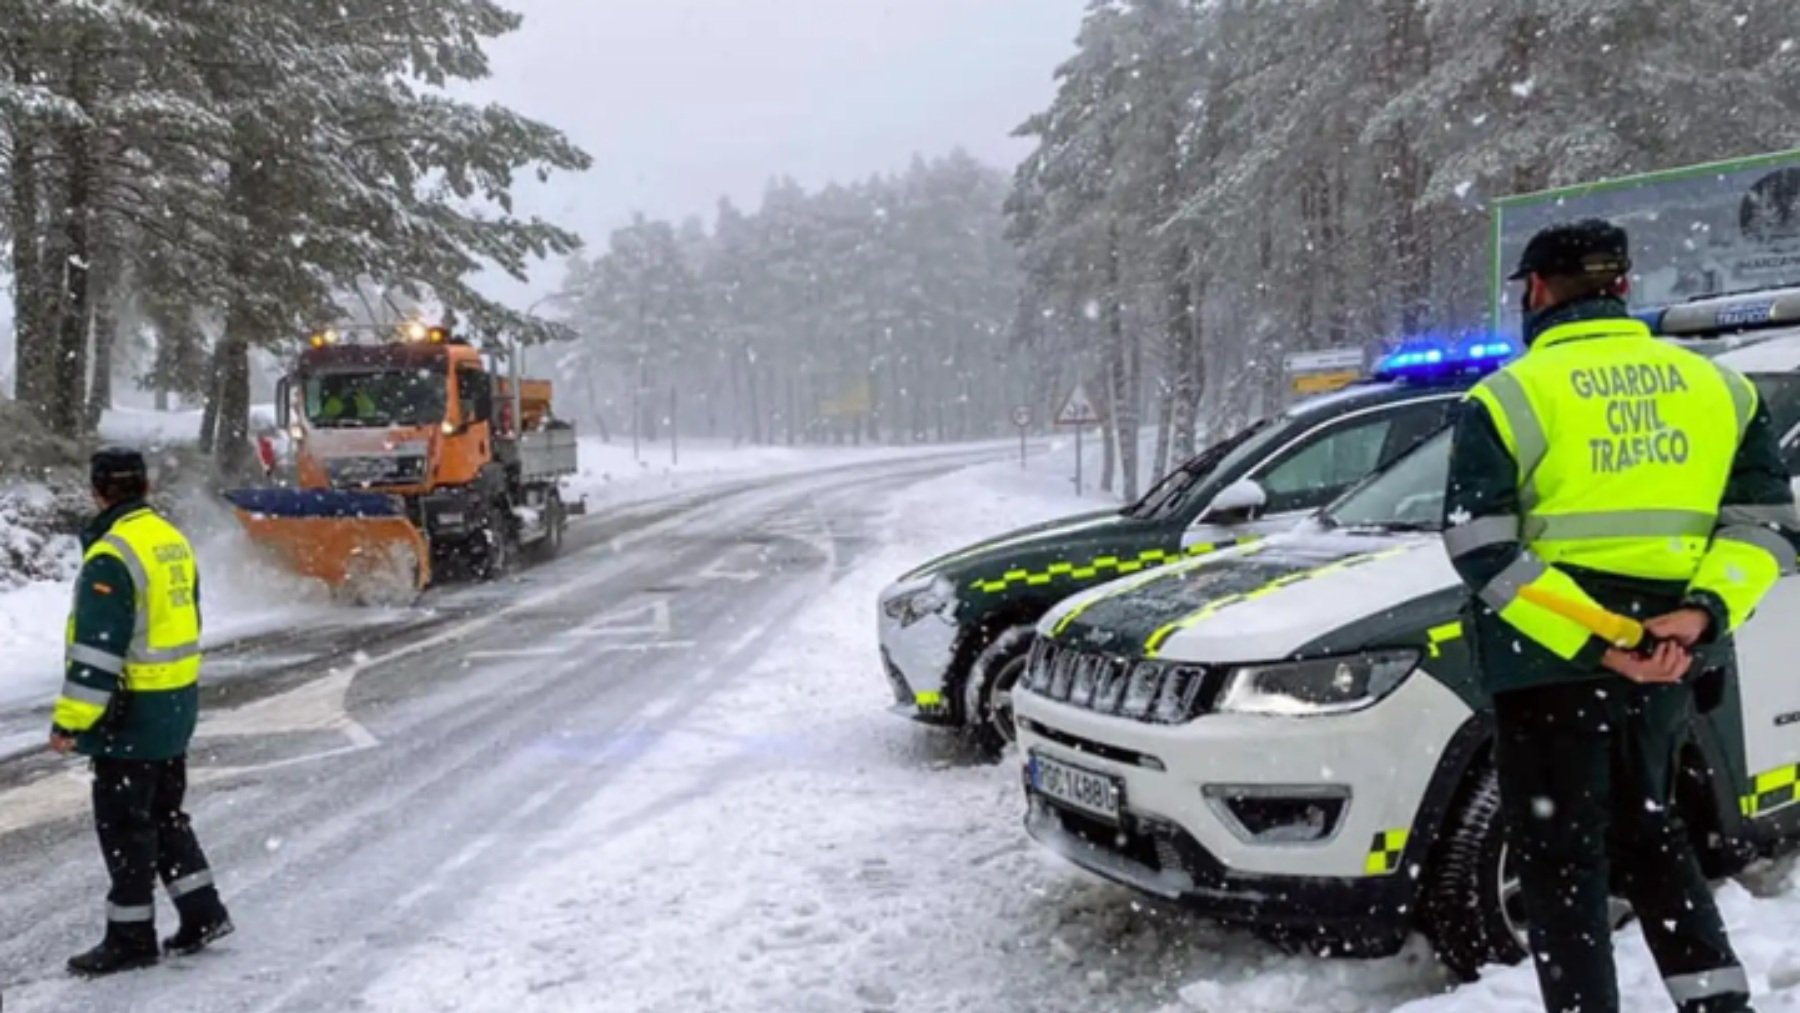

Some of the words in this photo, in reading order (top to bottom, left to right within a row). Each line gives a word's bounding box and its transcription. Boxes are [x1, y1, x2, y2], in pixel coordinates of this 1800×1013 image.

[1570, 364, 1687, 398] GUARDIA
[1606, 400, 1667, 434] CIVIL
[1589, 430, 1689, 473] TRAFICO
